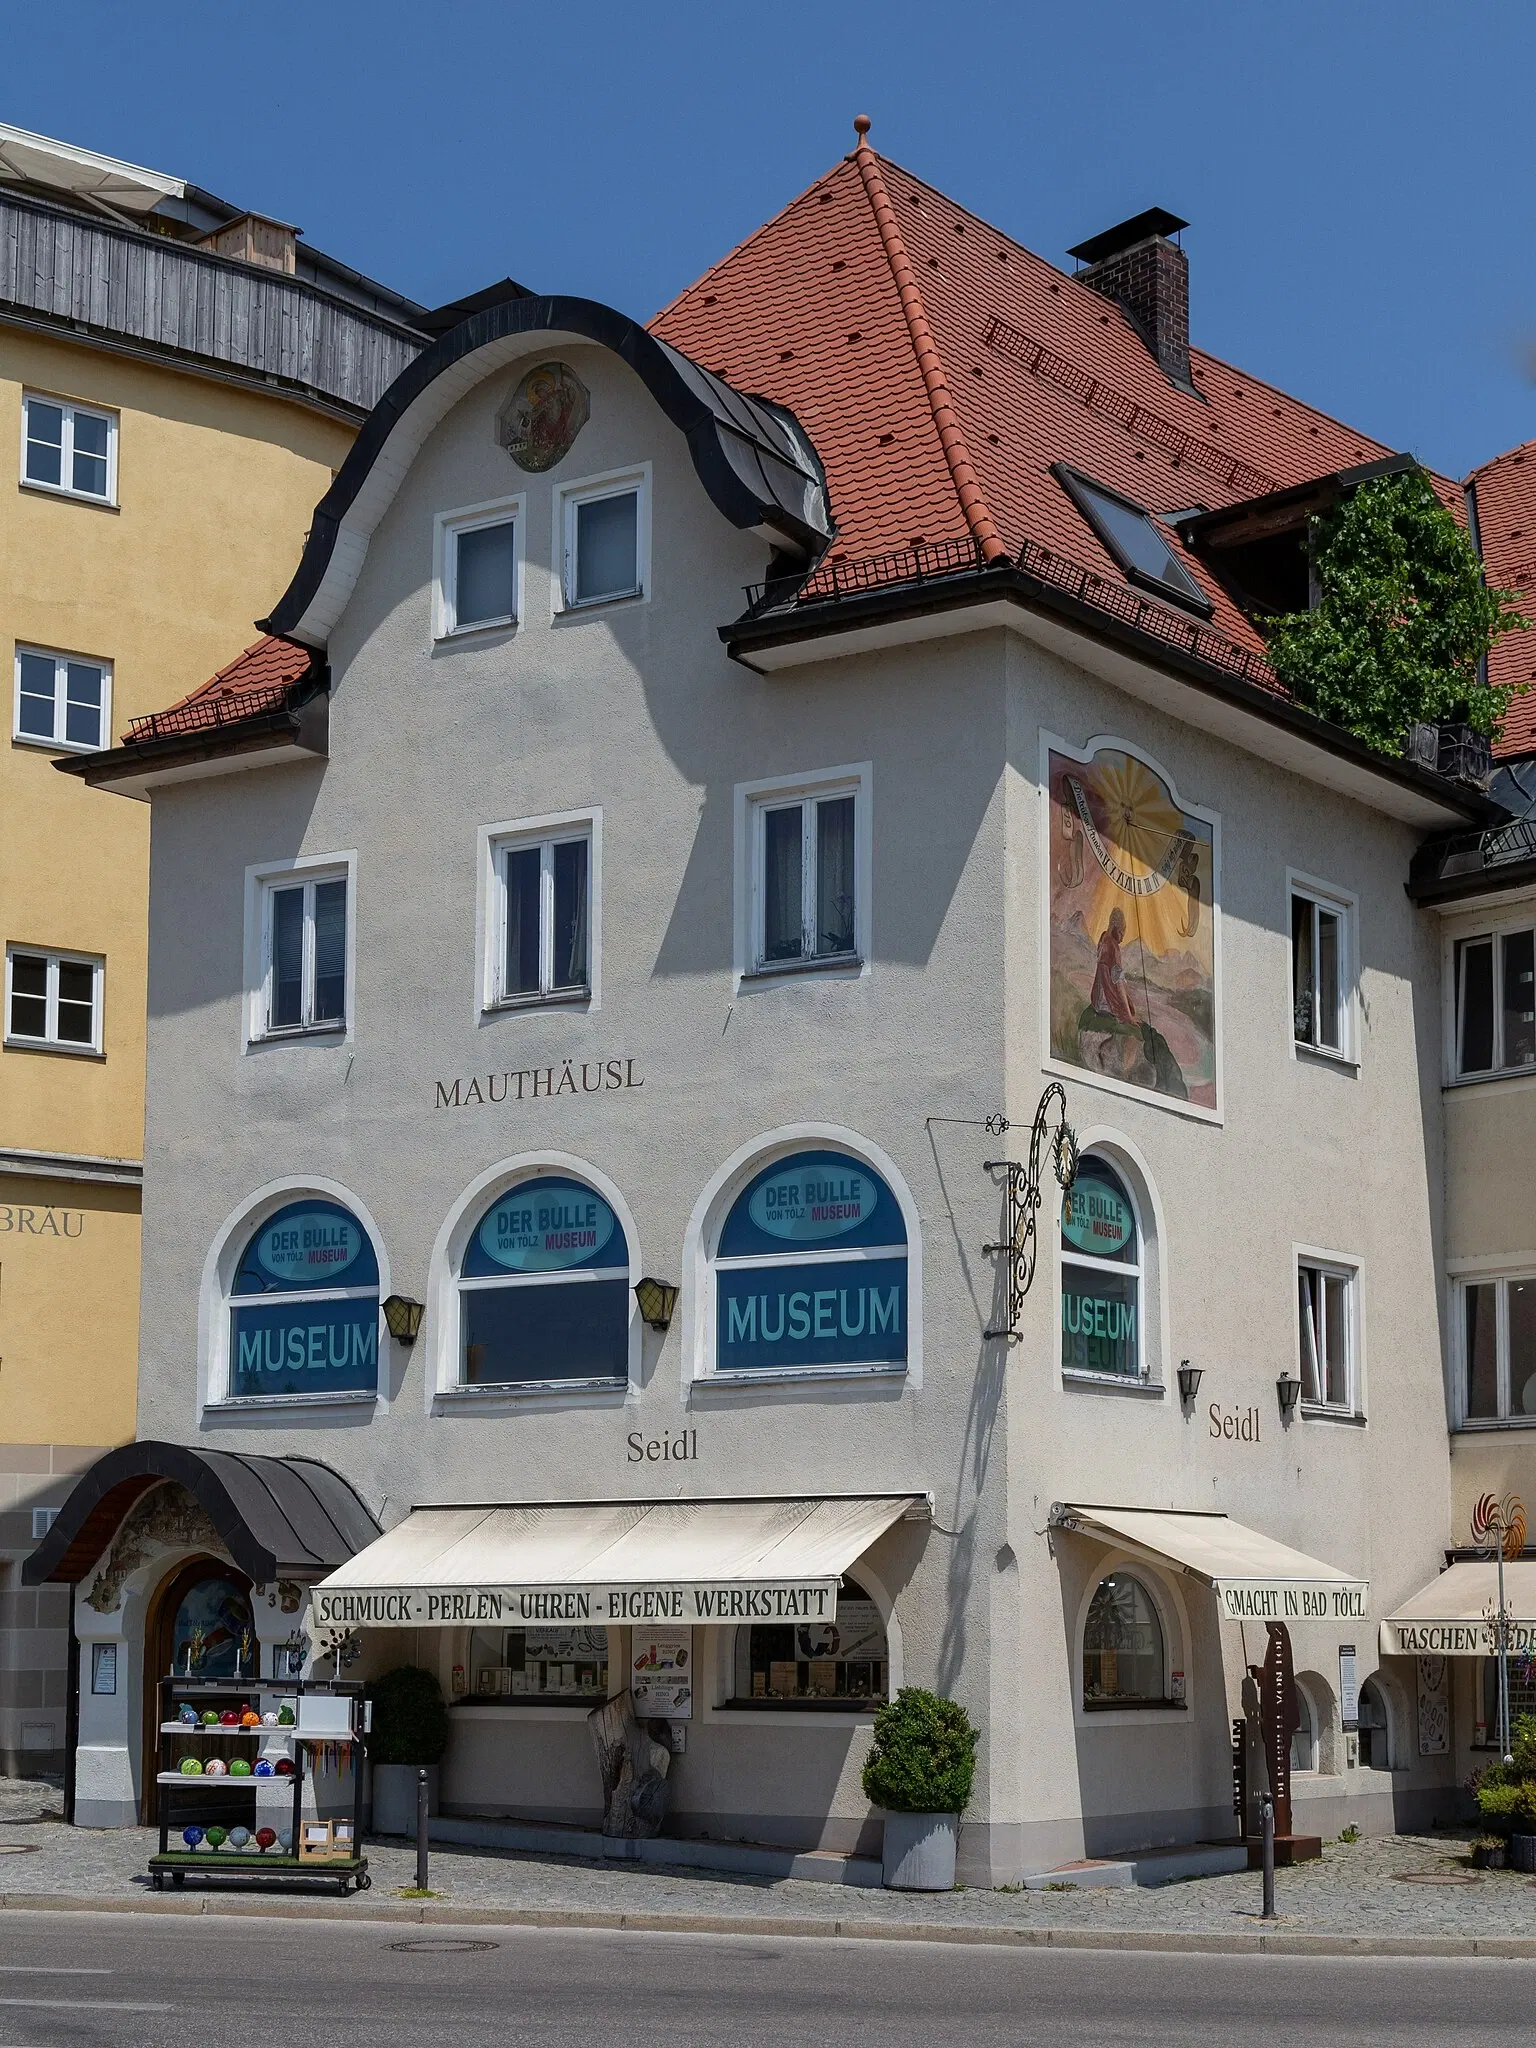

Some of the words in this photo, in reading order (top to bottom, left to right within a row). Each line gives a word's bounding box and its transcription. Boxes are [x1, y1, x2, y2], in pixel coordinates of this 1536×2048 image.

[434, 1058, 645, 1109] MAUTHÄUSL
[765, 1184, 800, 1208] DER
[805, 1179, 861, 1204] BULLE
[1070, 1190, 1086, 1215] ER
[1089, 1195, 1122, 1222] BULLE
[497, 1209, 533, 1235] DER
[538, 1204, 597, 1231] BULLE
[766, 1209, 783, 1221] VON
[784, 1207, 806, 1219] TÖLZ
[811, 1203, 861, 1222] MUSEUM
[271, 1231, 299, 1250] DER
[303, 1226, 348, 1249] BULLE
[497, 1238, 515, 1250] VON
[518, 1235, 539, 1247] TÖLZ
[545, 1230, 597, 1251] MUSEUM
[1093, 1220, 1122, 1241] MUSEUM
[271, 1253, 285, 1264] VON
[286, 1251, 303, 1263] TÖLZ
[308, 1248, 348, 1264] MUSEUM
[727, 1285, 901, 1344] MUSEUM
[238, 1322, 377, 1374] MUSEUM
[1209, 1403, 1261, 1443] Seidl
[627, 1428, 699, 1463] Seidl
[268, 1593, 277, 1608] 3
[319, 1595, 412, 1621] SCHMUCK
[427, 1593, 503, 1620] PERLEN
[520, 1592, 591, 1619] UHREN
[608, 1591, 683, 1618] EIGENE
[694, 1588, 829, 1617] WERKSTATT
[1225, 1590, 1279, 1616] GMACHT
[1283, 1590, 1299, 1616] IN
[1302, 1590, 1327, 1617] BAD
[1333, 1587, 1365, 1617] TÖLZ
[1398, 1628, 1477, 1650] TASCHEN
